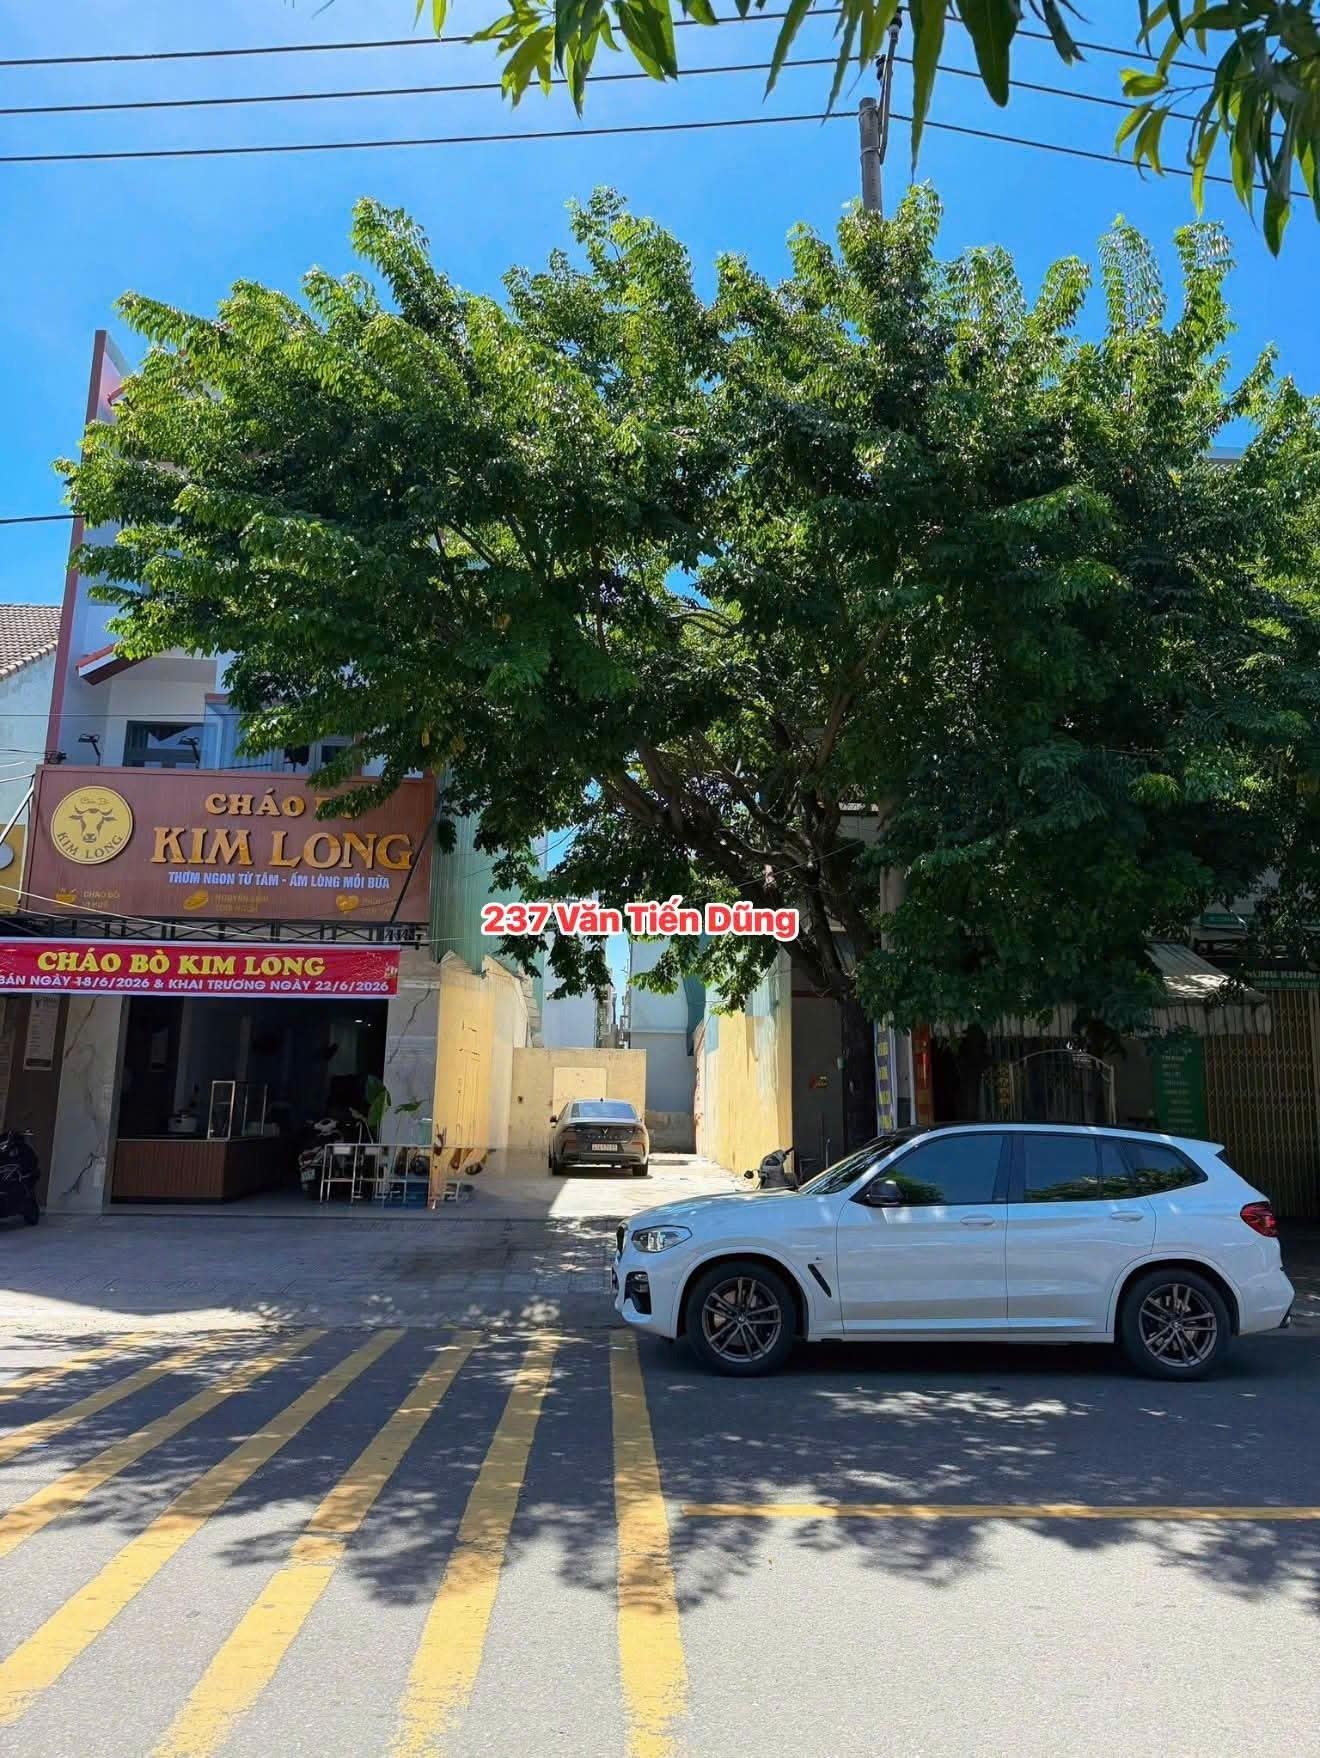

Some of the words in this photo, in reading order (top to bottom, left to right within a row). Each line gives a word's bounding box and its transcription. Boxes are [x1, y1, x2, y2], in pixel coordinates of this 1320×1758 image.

[205, 787, 305, 817] CHÁO
[57, 832, 79, 856] KIM
[85, 834, 123, 859] LONG
[151, 826, 253, 866] KIM
[268, 831, 413, 871] LONG
[168, 871, 201, 884] THƠM
[203, 872, 235, 885] NGON
[255, 872, 280, 886] TÂM
[37, 947, 122, 973] CHÁO
[128, 949, 170, 974] BÒ
[177, 954, 237, 977] KIM
[243, 956, 326, 977] LONG
[30, 973, 72, 986] NGÀY
[74, 976, 150, 989] 18/6/2026
[153, 979, 165, 989] &
[168, 979, 203, 990] KHAI
[207, 979, 266, 991] TRƯƠNG
[270, 977, 311, 991] NGÀY
[314, 981, 390, 993] 22/6/2026
